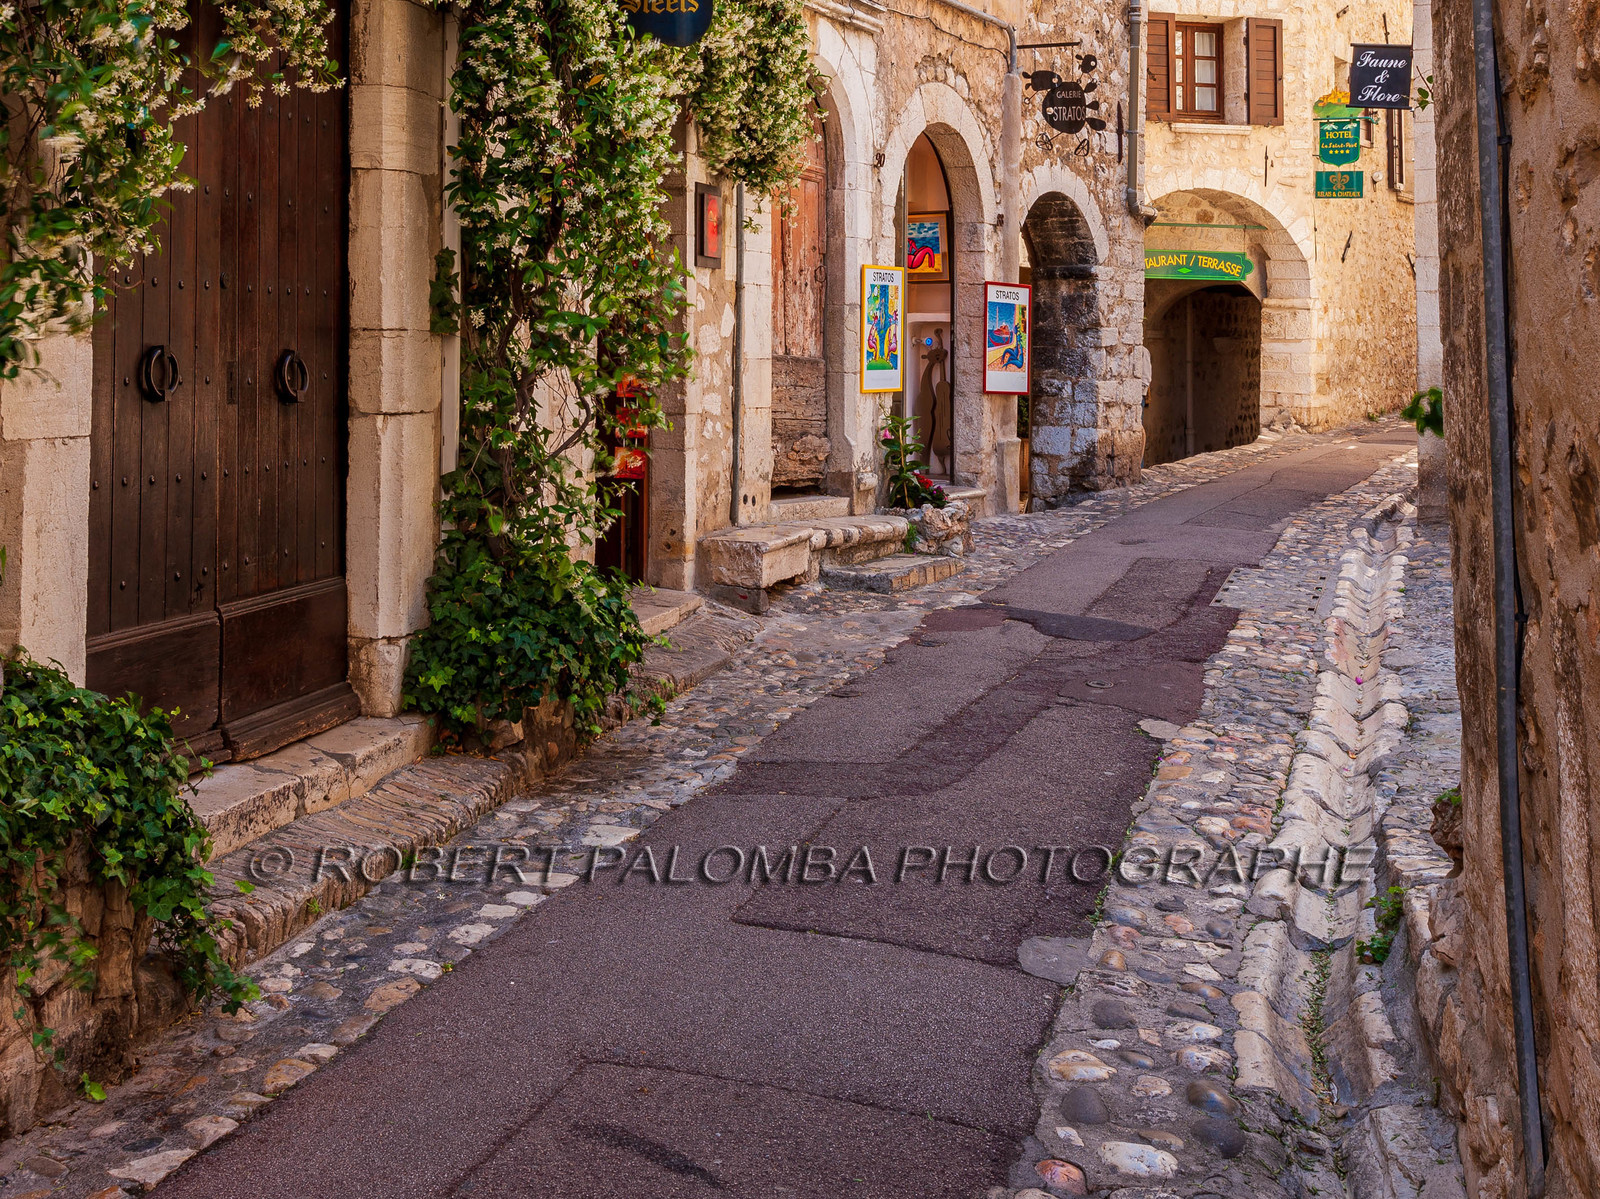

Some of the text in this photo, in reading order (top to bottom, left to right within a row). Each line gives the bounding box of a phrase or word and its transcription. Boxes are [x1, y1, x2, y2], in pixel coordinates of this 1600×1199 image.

[1356, 50, 1408, 69] Faune
[1374, 69, 1390, 84] &
[1056, 90, 1082, 99] GALERIE
[1357, 84, 1402, 103] Flore
[1052, 105, 1087, 122] STRATOS
[1325, 130, 1354, 139] HOTEL
[1197, 255, 1243, 278] TERRASSE
[872, 271, 895, 283] STRATOS
[995, 289, 1020, 301] STRATOS
